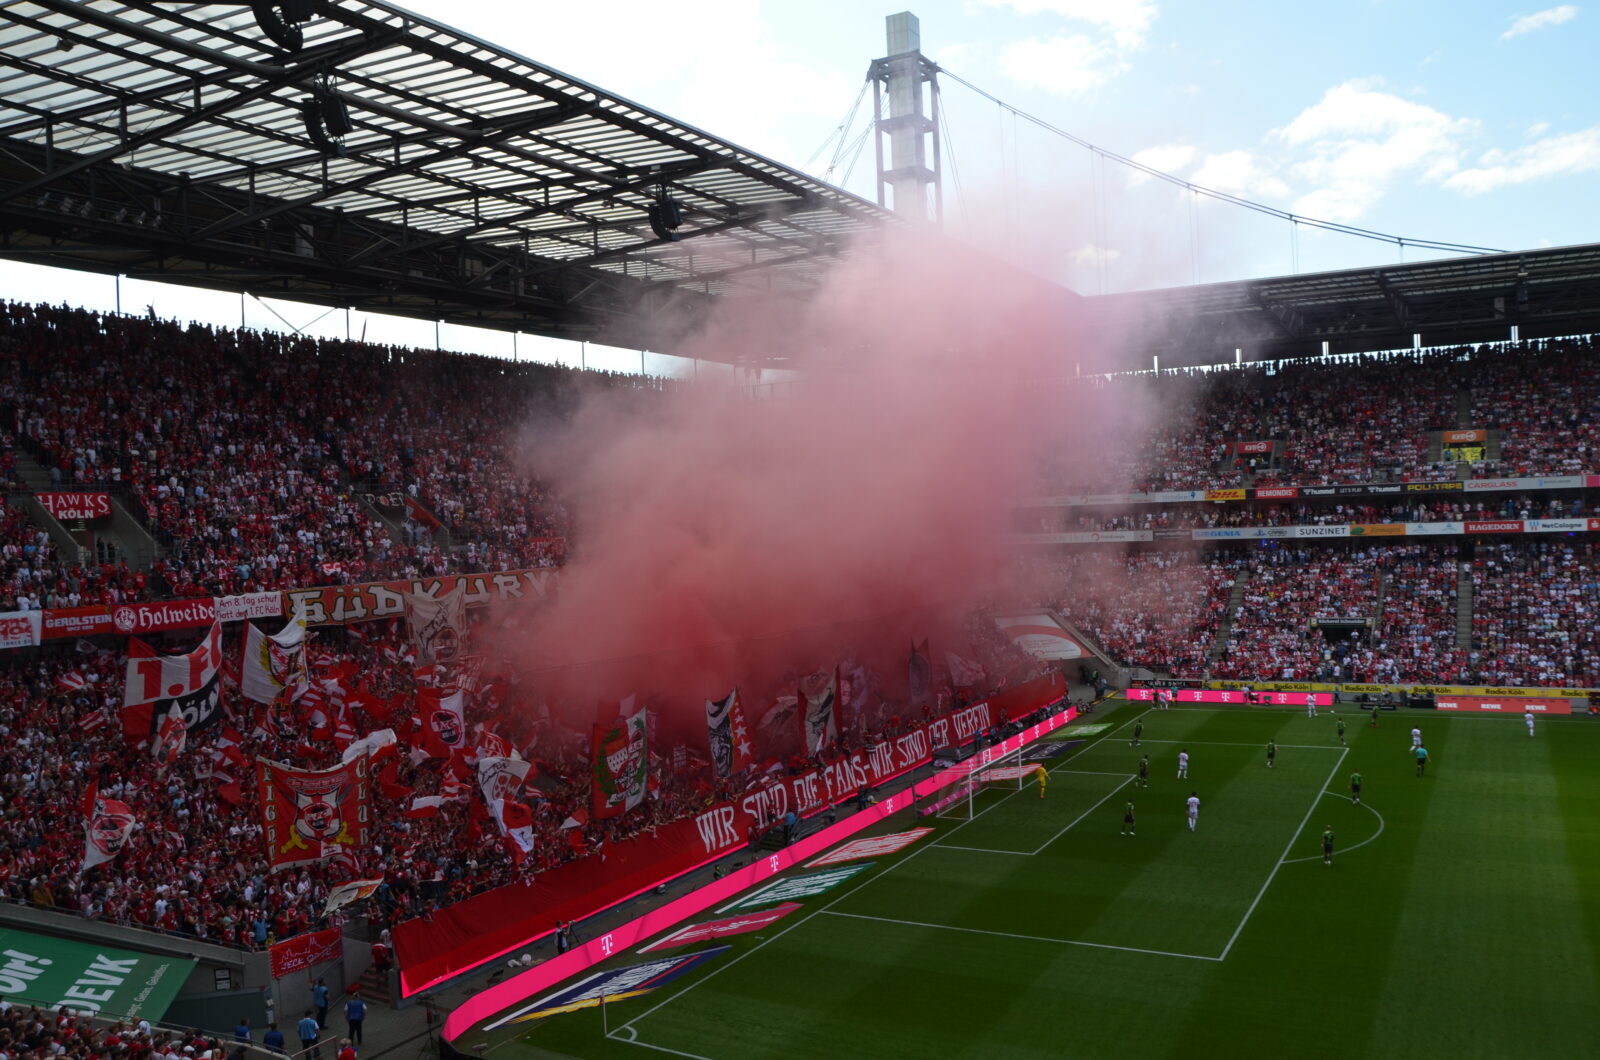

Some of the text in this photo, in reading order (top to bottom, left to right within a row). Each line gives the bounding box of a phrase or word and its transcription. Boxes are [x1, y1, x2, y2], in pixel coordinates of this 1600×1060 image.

[1407, 482, 1463, 491] POLI-TAPE
[1467, 481, 1518, 489] CARGLASS
[1258, 489, 1293, 497] REMONDIS
[58, 507, 94, 519] KÖLN
[1299, 527, 1347, 536] SUNZINET
[1468, 523, 1520, 532] HAGEDORN
[1541, 522, 1582, 531] NetCologne
[288, 571, 560, 622] SÜDKURV
[46, 614, 112, 628] GEROLSTEIN
[1508, 688, 1525, 696] Köln
[695, 806, 739, 854] WIR
[742, 783, 788, 829] SIND
[793, 772, 823, 813] DIE
[896, 729, 927, 768] SIND
[928, 718, 949, 752] DER
[952, 702, 991, 741] VEREIN
[769, 854, 780, 872] T
[601, 933, 614, 956] T
[52, 953, 140, 1017] DEVK
